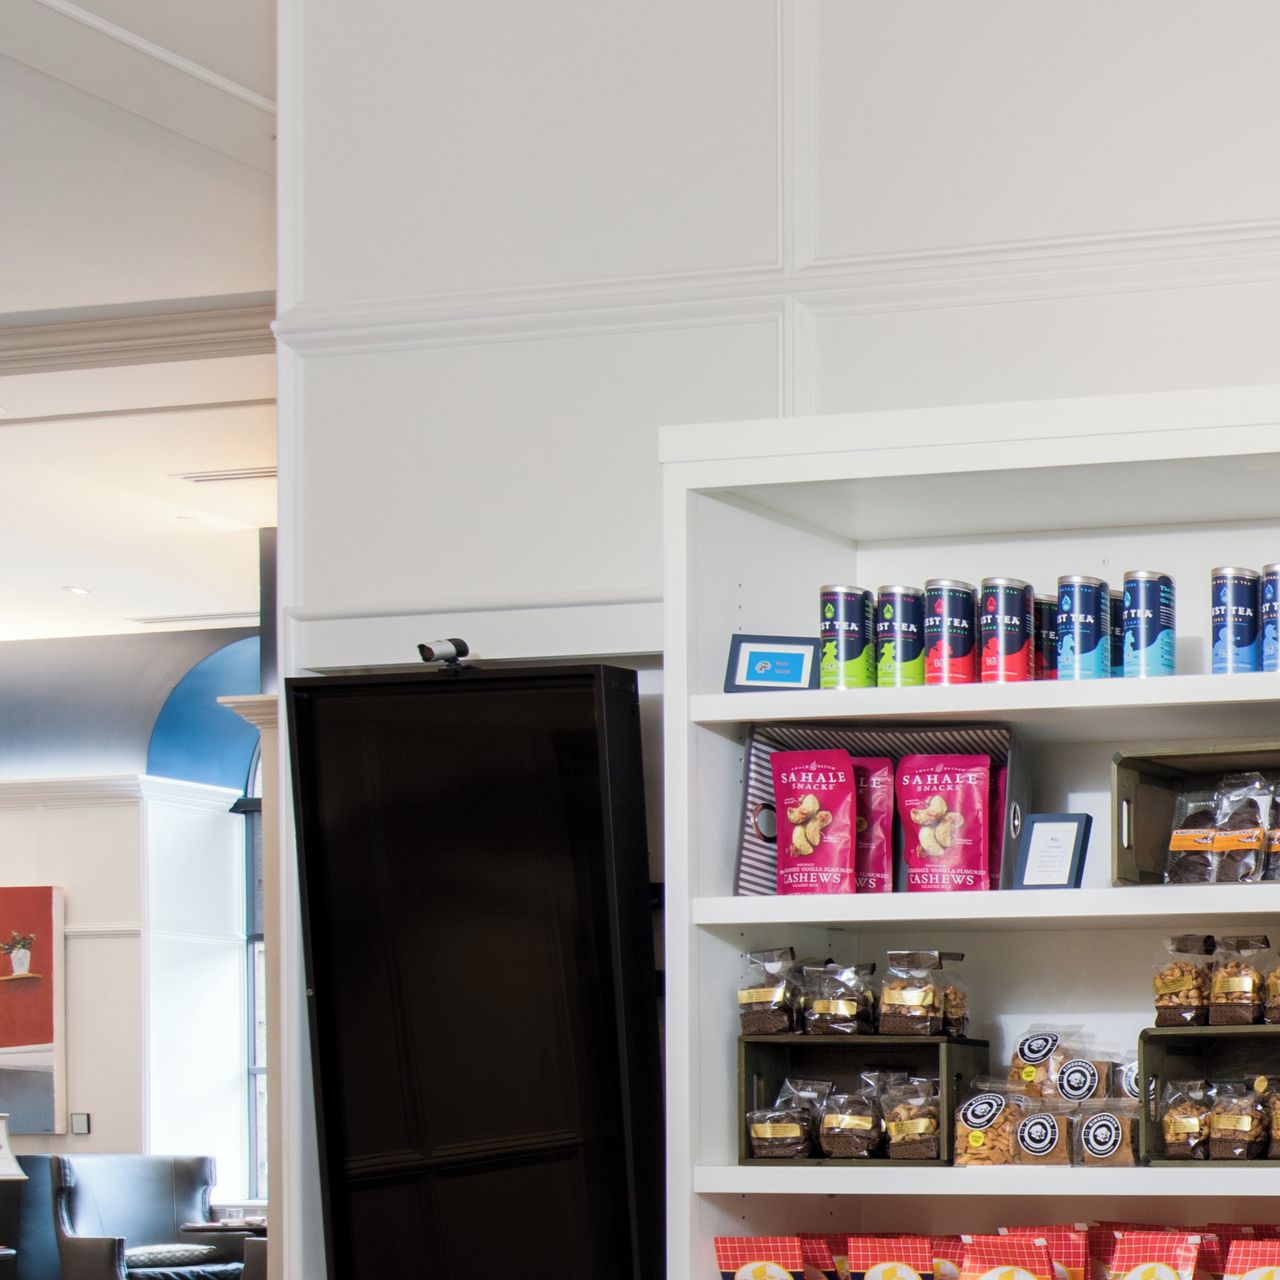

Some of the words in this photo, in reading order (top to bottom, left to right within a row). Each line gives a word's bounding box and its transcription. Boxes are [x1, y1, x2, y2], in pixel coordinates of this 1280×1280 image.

[1130, 609, 1153, 619] TEA
[1231, 605, 1253, 617] TEA
[945, 617, 969, 628] TEA
[995, 615, 1020, 626] TEA
[1070, 613, 1095, 624] TEA
[833, 620, 859, 632] TEA
[892, 621, 918, 633] TEA
[780, 771, 847, 784] SAHALE
[902, 774, 979, 786] SAHALE
[791, 782, 836, 791] SNACKS
[915, 784, 962, 792] SNACKS
[783, 872, 842, 886] CASHEWS
[909, 874, 975, 886] CASHEWS
